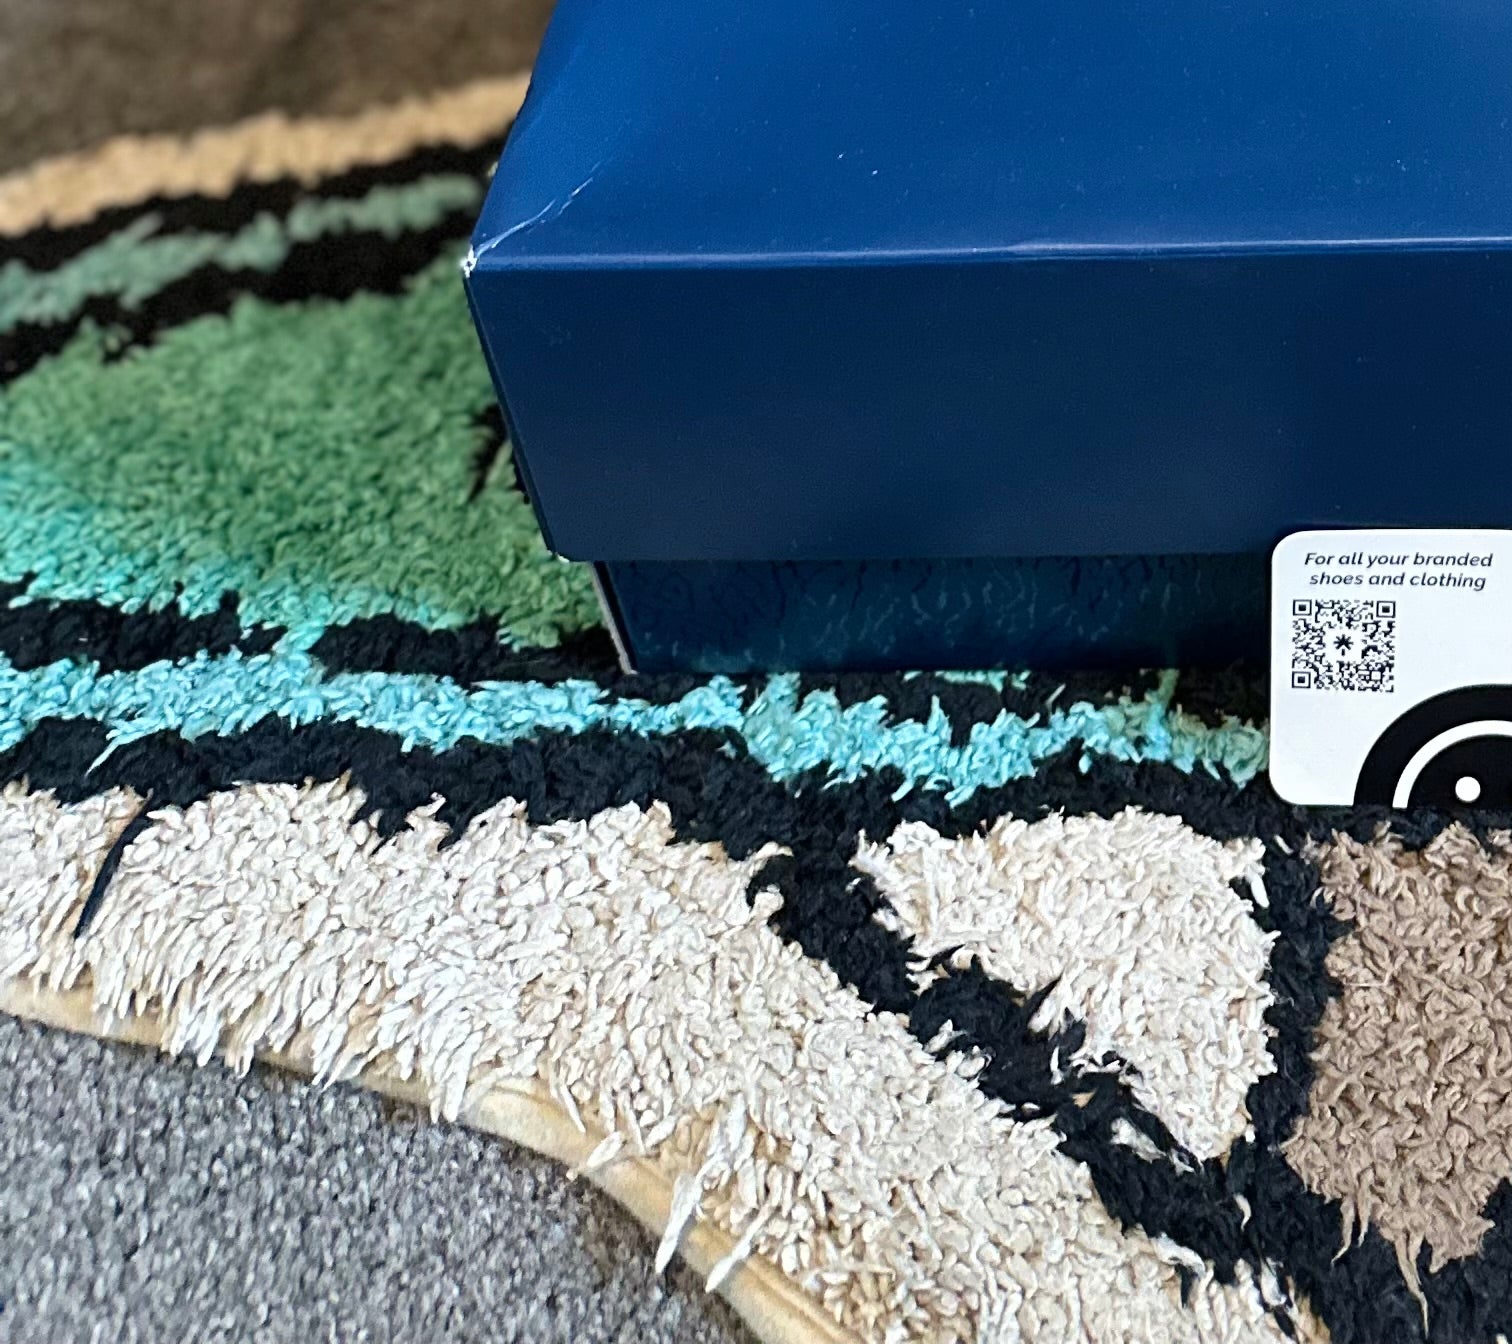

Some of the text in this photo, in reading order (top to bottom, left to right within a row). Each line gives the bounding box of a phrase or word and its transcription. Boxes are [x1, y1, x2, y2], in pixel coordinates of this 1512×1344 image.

[1305, 552, 1494, 571] For all your branded
[1310, 572, 1486, 591] shoes and clothing
